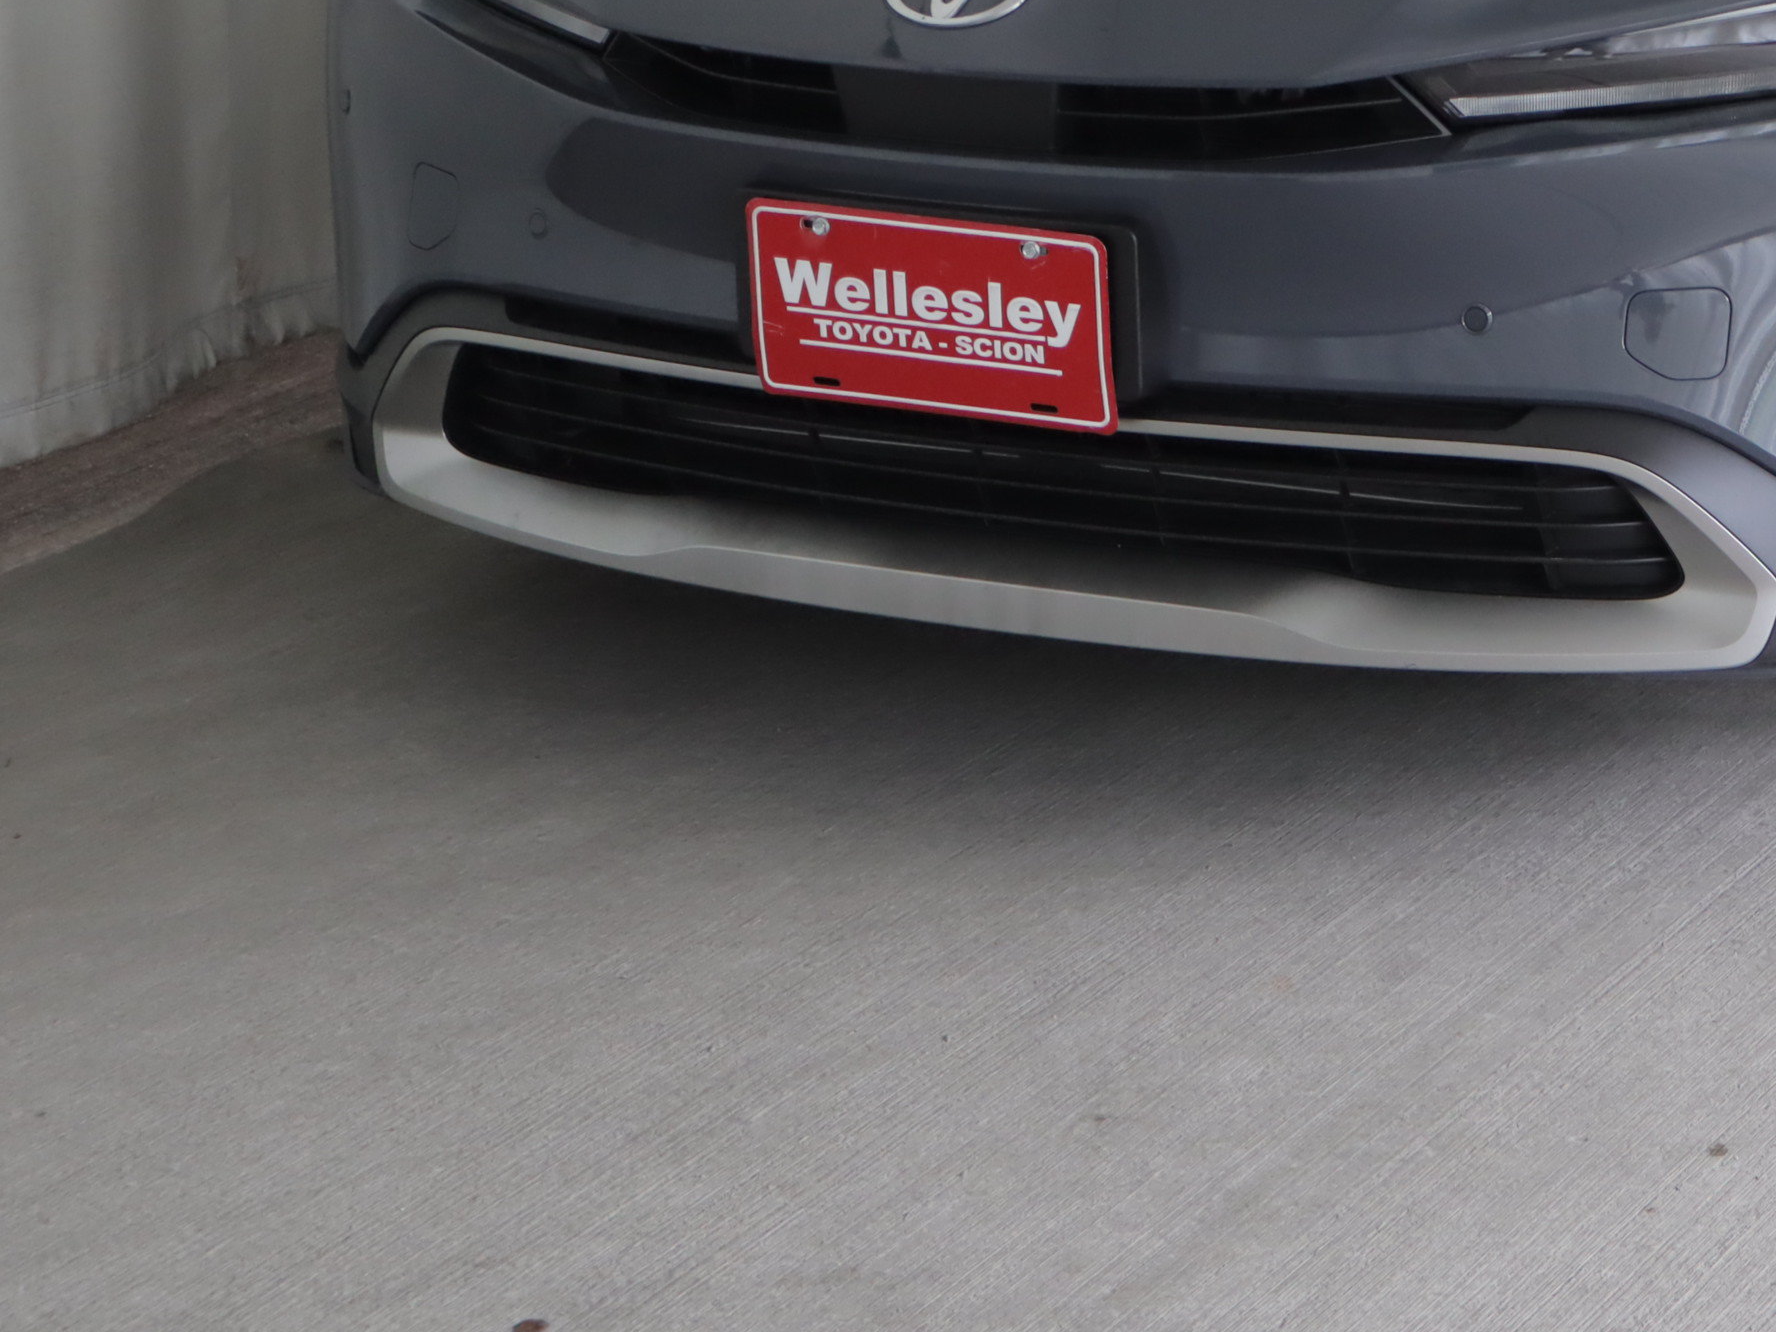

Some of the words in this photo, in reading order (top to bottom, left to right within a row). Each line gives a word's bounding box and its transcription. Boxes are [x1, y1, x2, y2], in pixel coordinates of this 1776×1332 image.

[773, 256, 1081, 348] Wellesley
[813, 318, 932, 351] TOYOTA
[955, 336, 1045, 365] SCION
